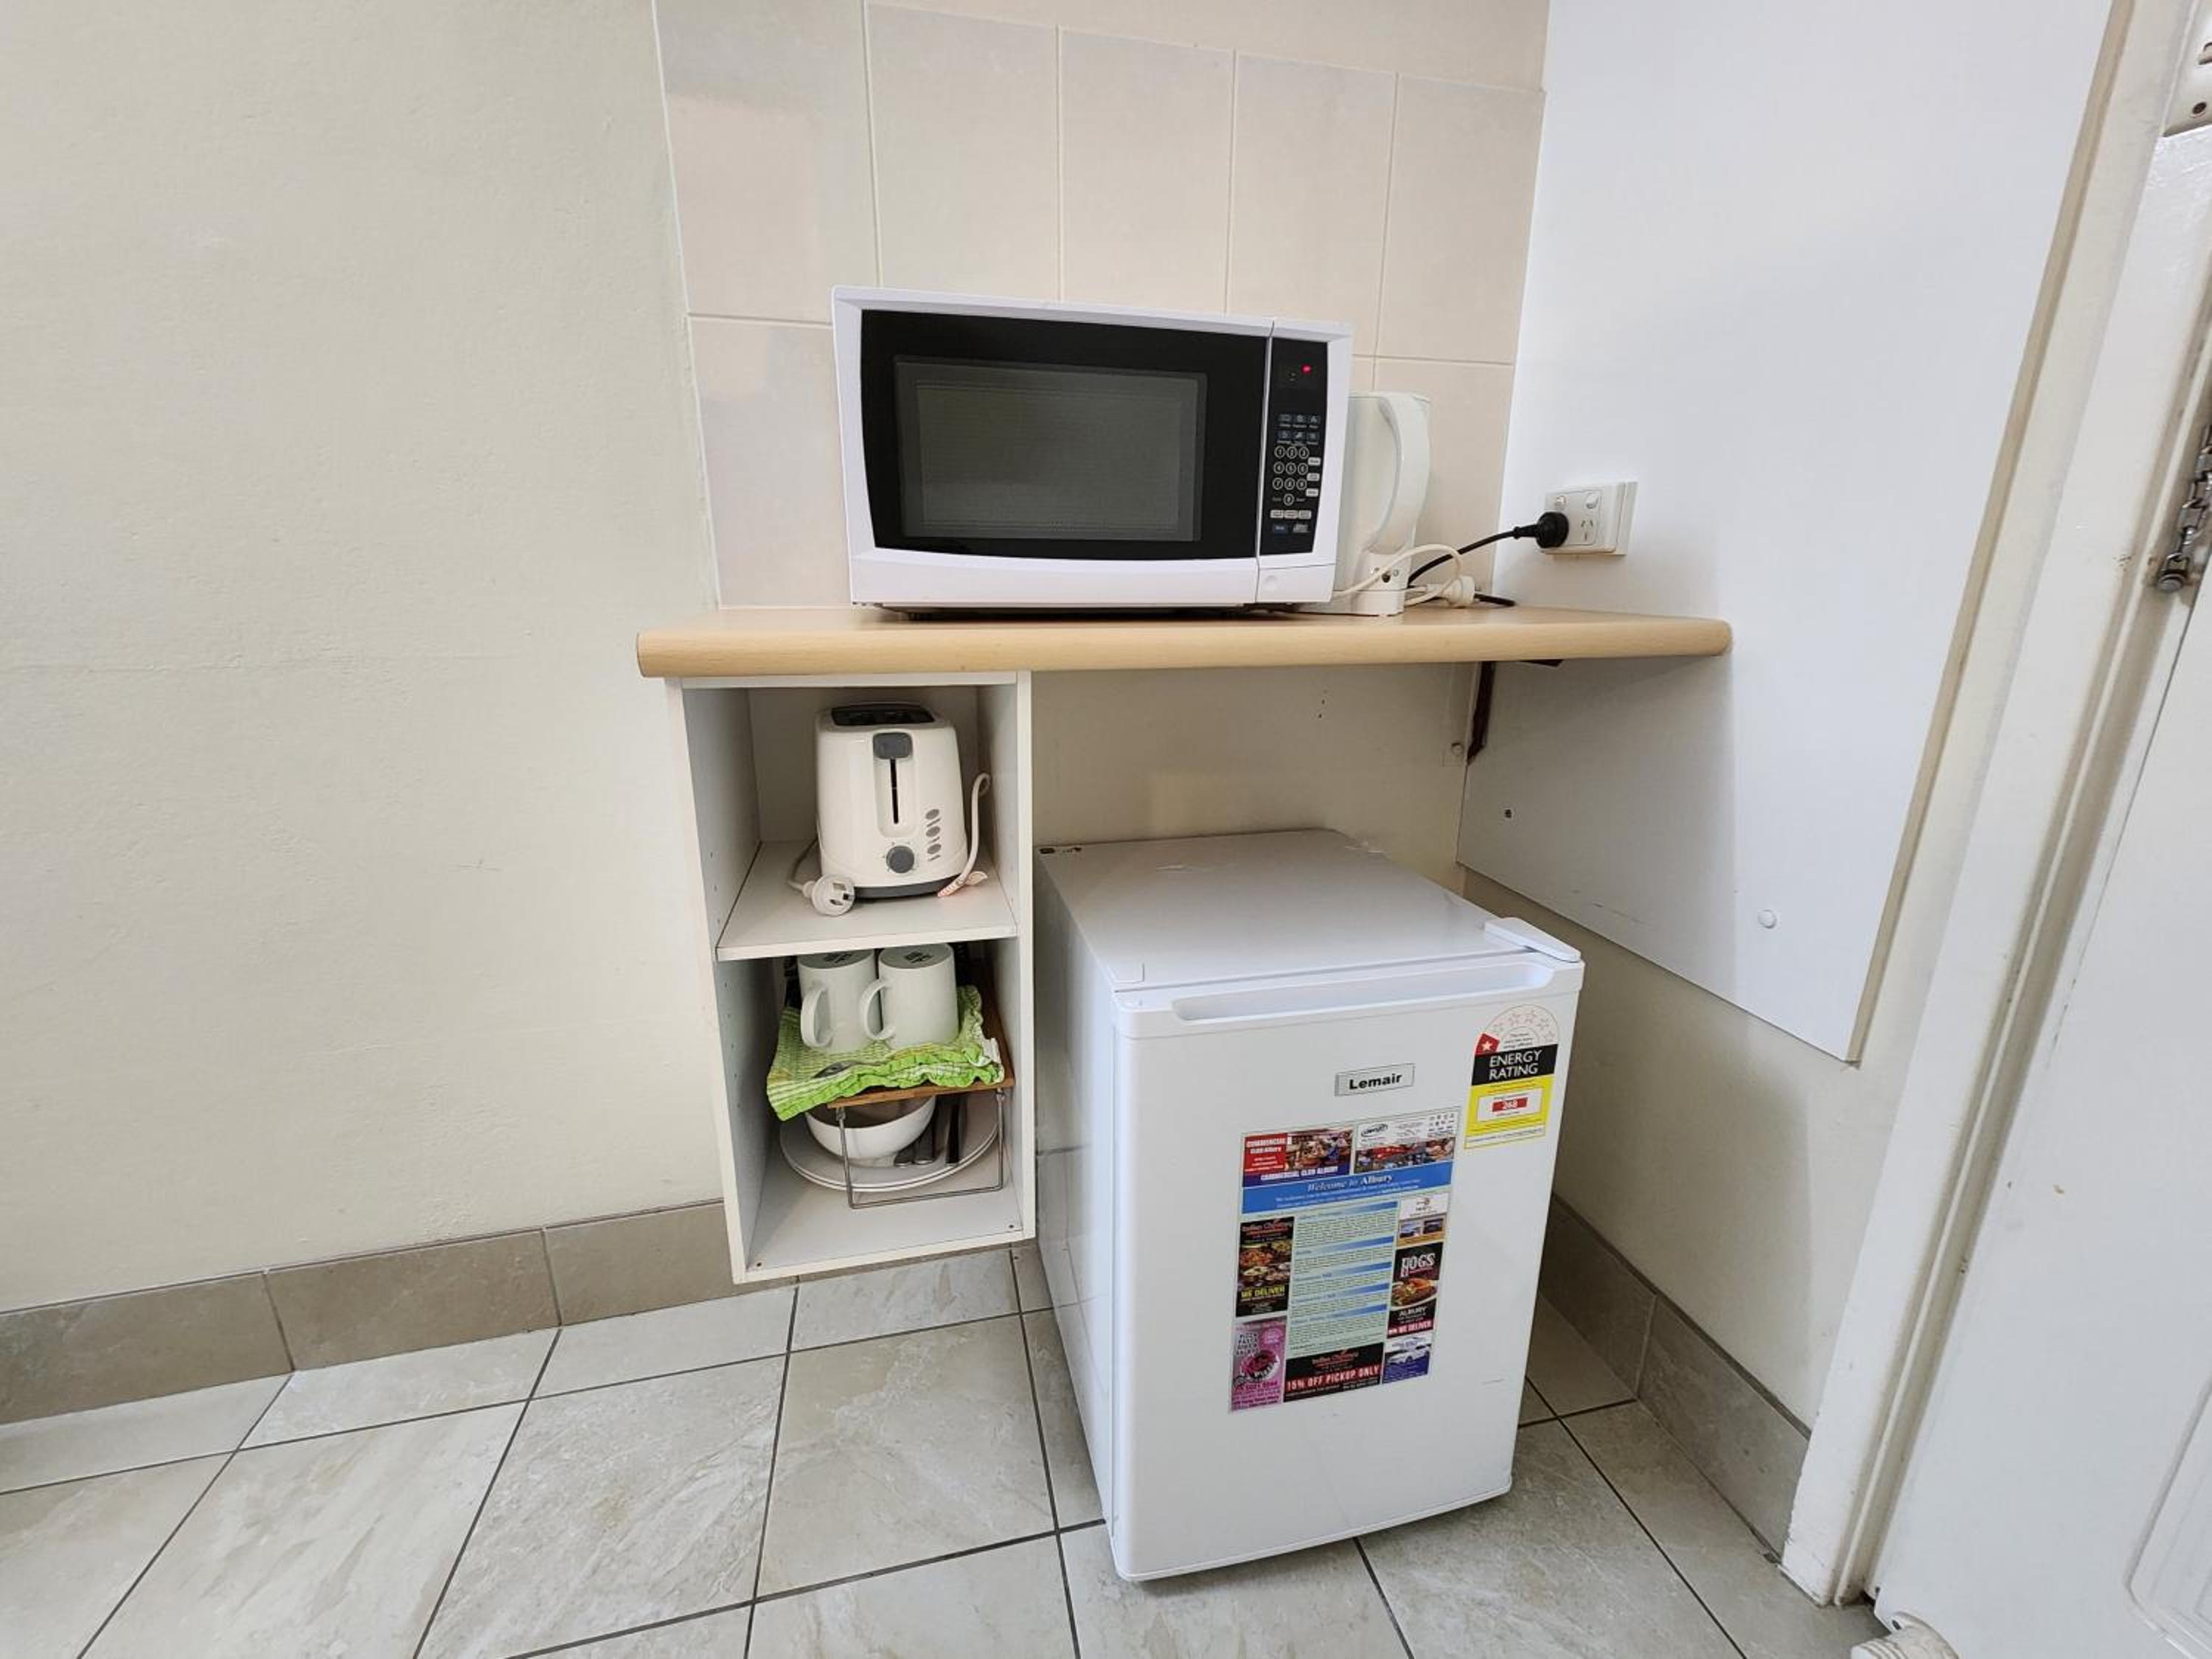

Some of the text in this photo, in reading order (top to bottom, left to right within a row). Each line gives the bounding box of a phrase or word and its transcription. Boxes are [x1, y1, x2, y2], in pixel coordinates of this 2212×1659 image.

[1489, 1049, 1543, 1068] ENERGY
[1489, 1063, 1539, 1080] RATING
[1349, 1074, 1402, 1090] Lemair
[1307, 1182, 1346, 1192] Welcome
[1361, 1175, 1393, 1185] Albury
[1254, 1285, 1285, 1296] DELIVER
[1408, 1320, 1431, 1332] DELIVER
[1287, 1379, 1305, 1391] 15%
[1307, 1375, 1323, 1387] OFF
[1326, 1369, 1357, 1384] PICKUP
[1357, 1365, 1380, 1377] ONLY
